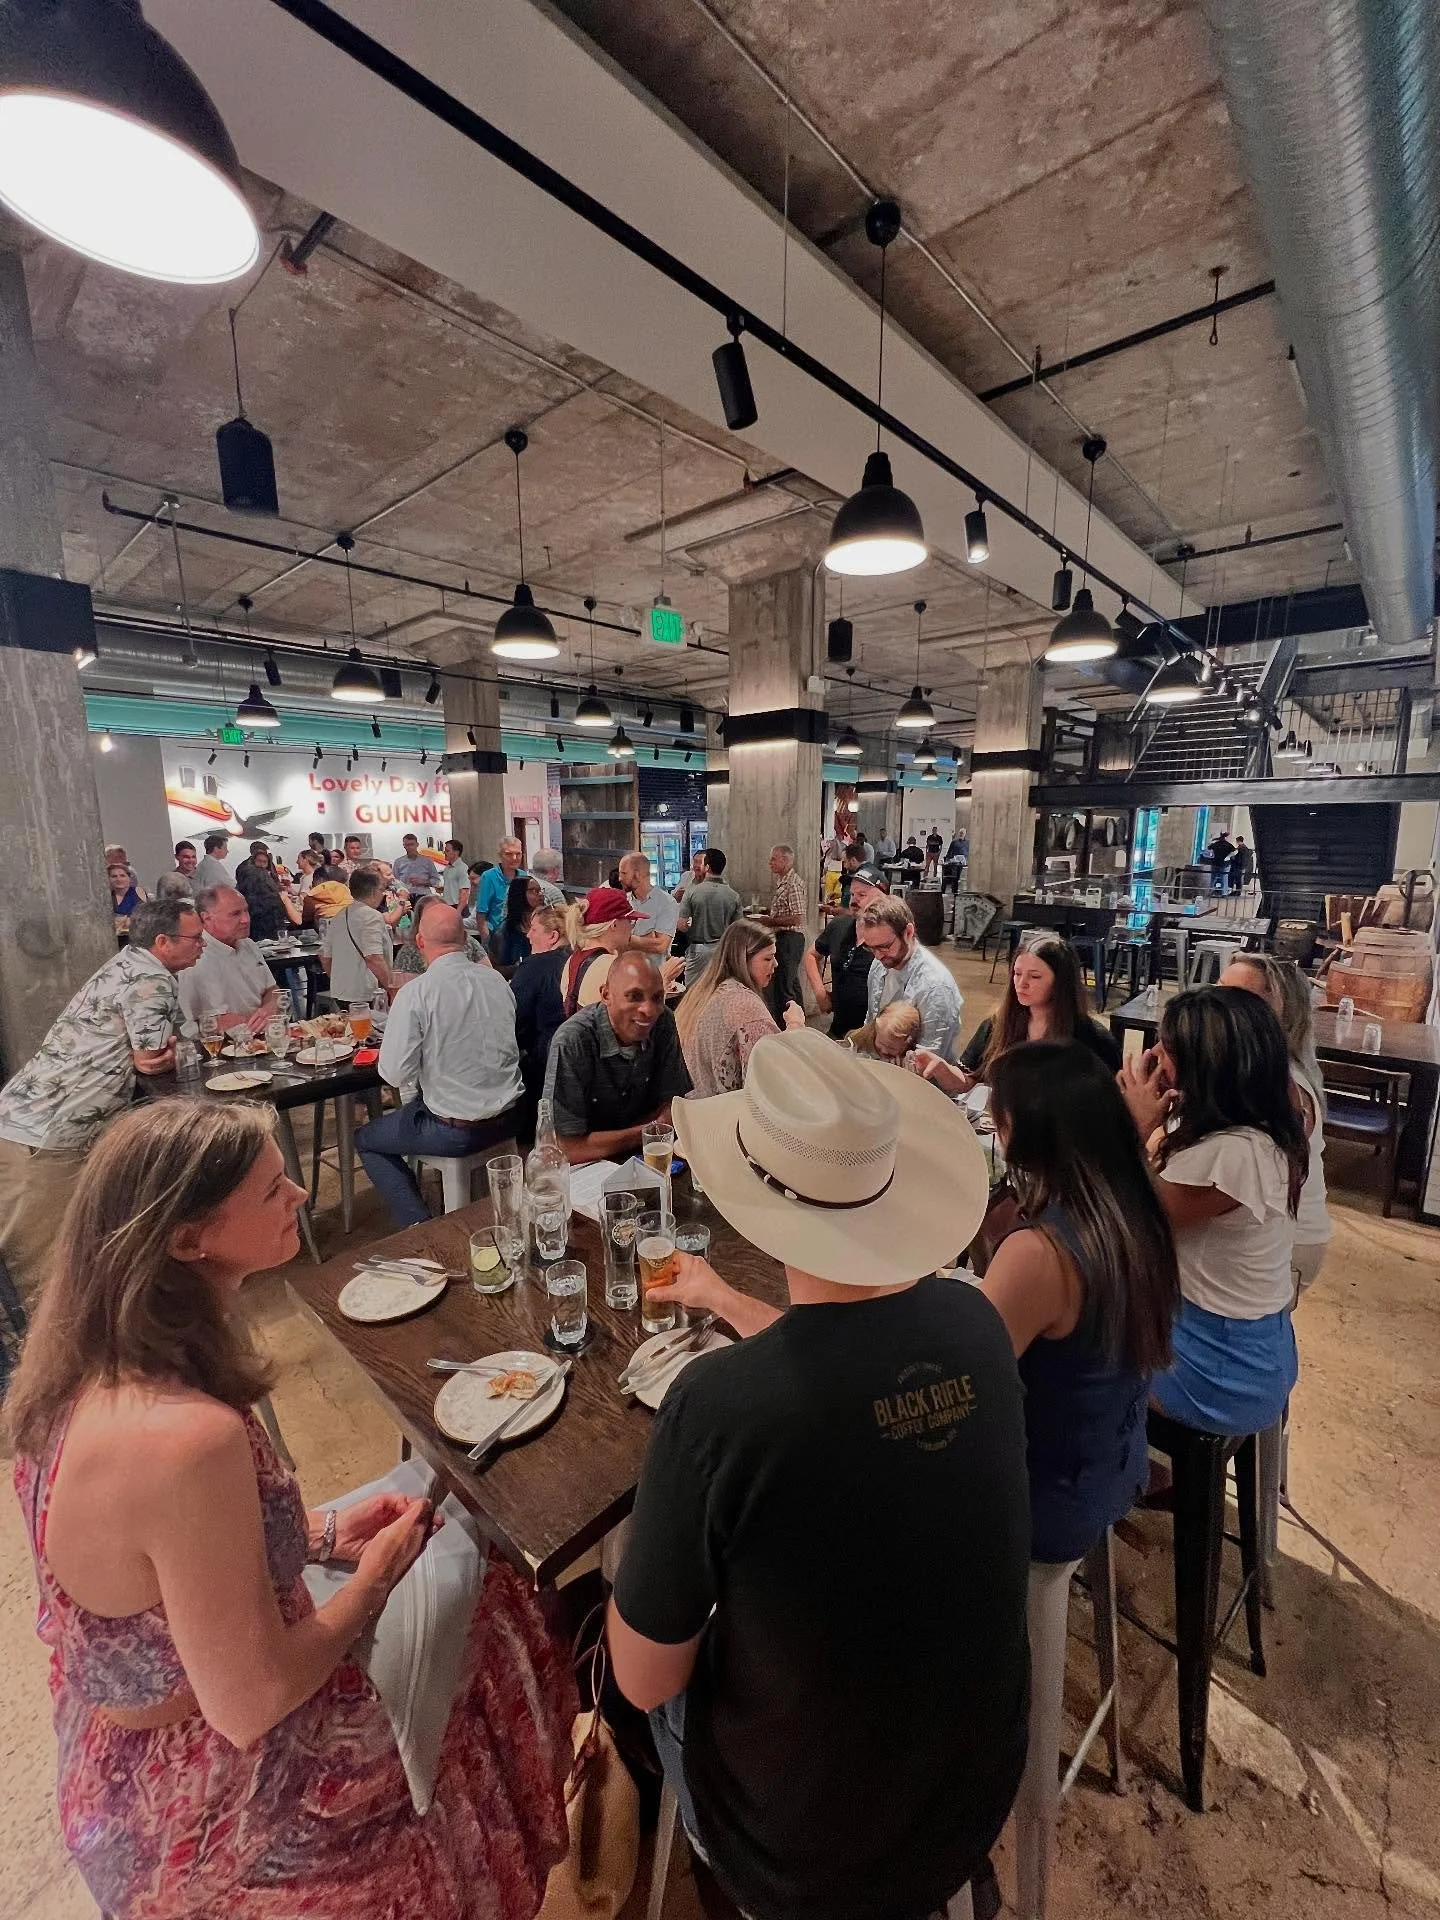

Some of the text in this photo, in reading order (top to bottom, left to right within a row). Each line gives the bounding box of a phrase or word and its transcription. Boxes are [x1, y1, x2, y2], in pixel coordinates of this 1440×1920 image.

[652, 610, 682, 642] EXIT
[222, 729, 243, 744] EXIT
[309, 772, 382, 796] Lovely
[389, 776, 429, 798] Day
[355, 804, 451, 823] GUINNE
[872, 1375, 976, 1427] BLACK RIFLE
[926, 1402, 970, 1429] COMPANY
